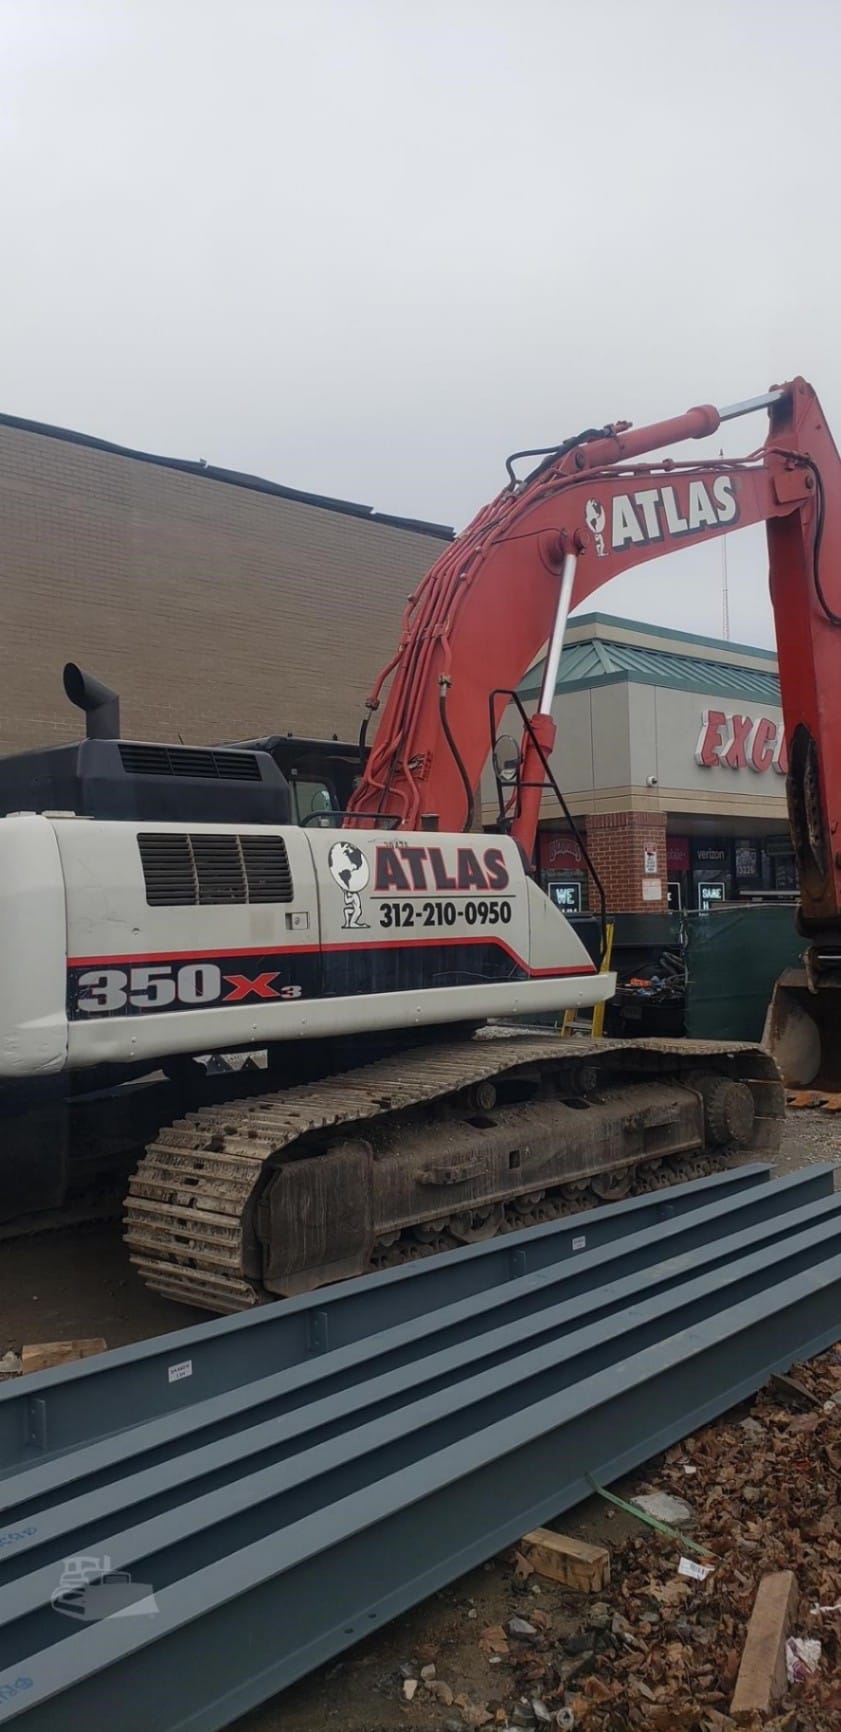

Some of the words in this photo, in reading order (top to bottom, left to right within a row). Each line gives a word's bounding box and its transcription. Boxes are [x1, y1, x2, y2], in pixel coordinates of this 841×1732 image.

[612, 475, 738, 548] ATLAS
[697, 848, 725, 860] verizon
[374, 847, 510, 892] ATLAS
[555, 888, 575, 905] WE
[379, 901, 512, 928] 312-210-0950
